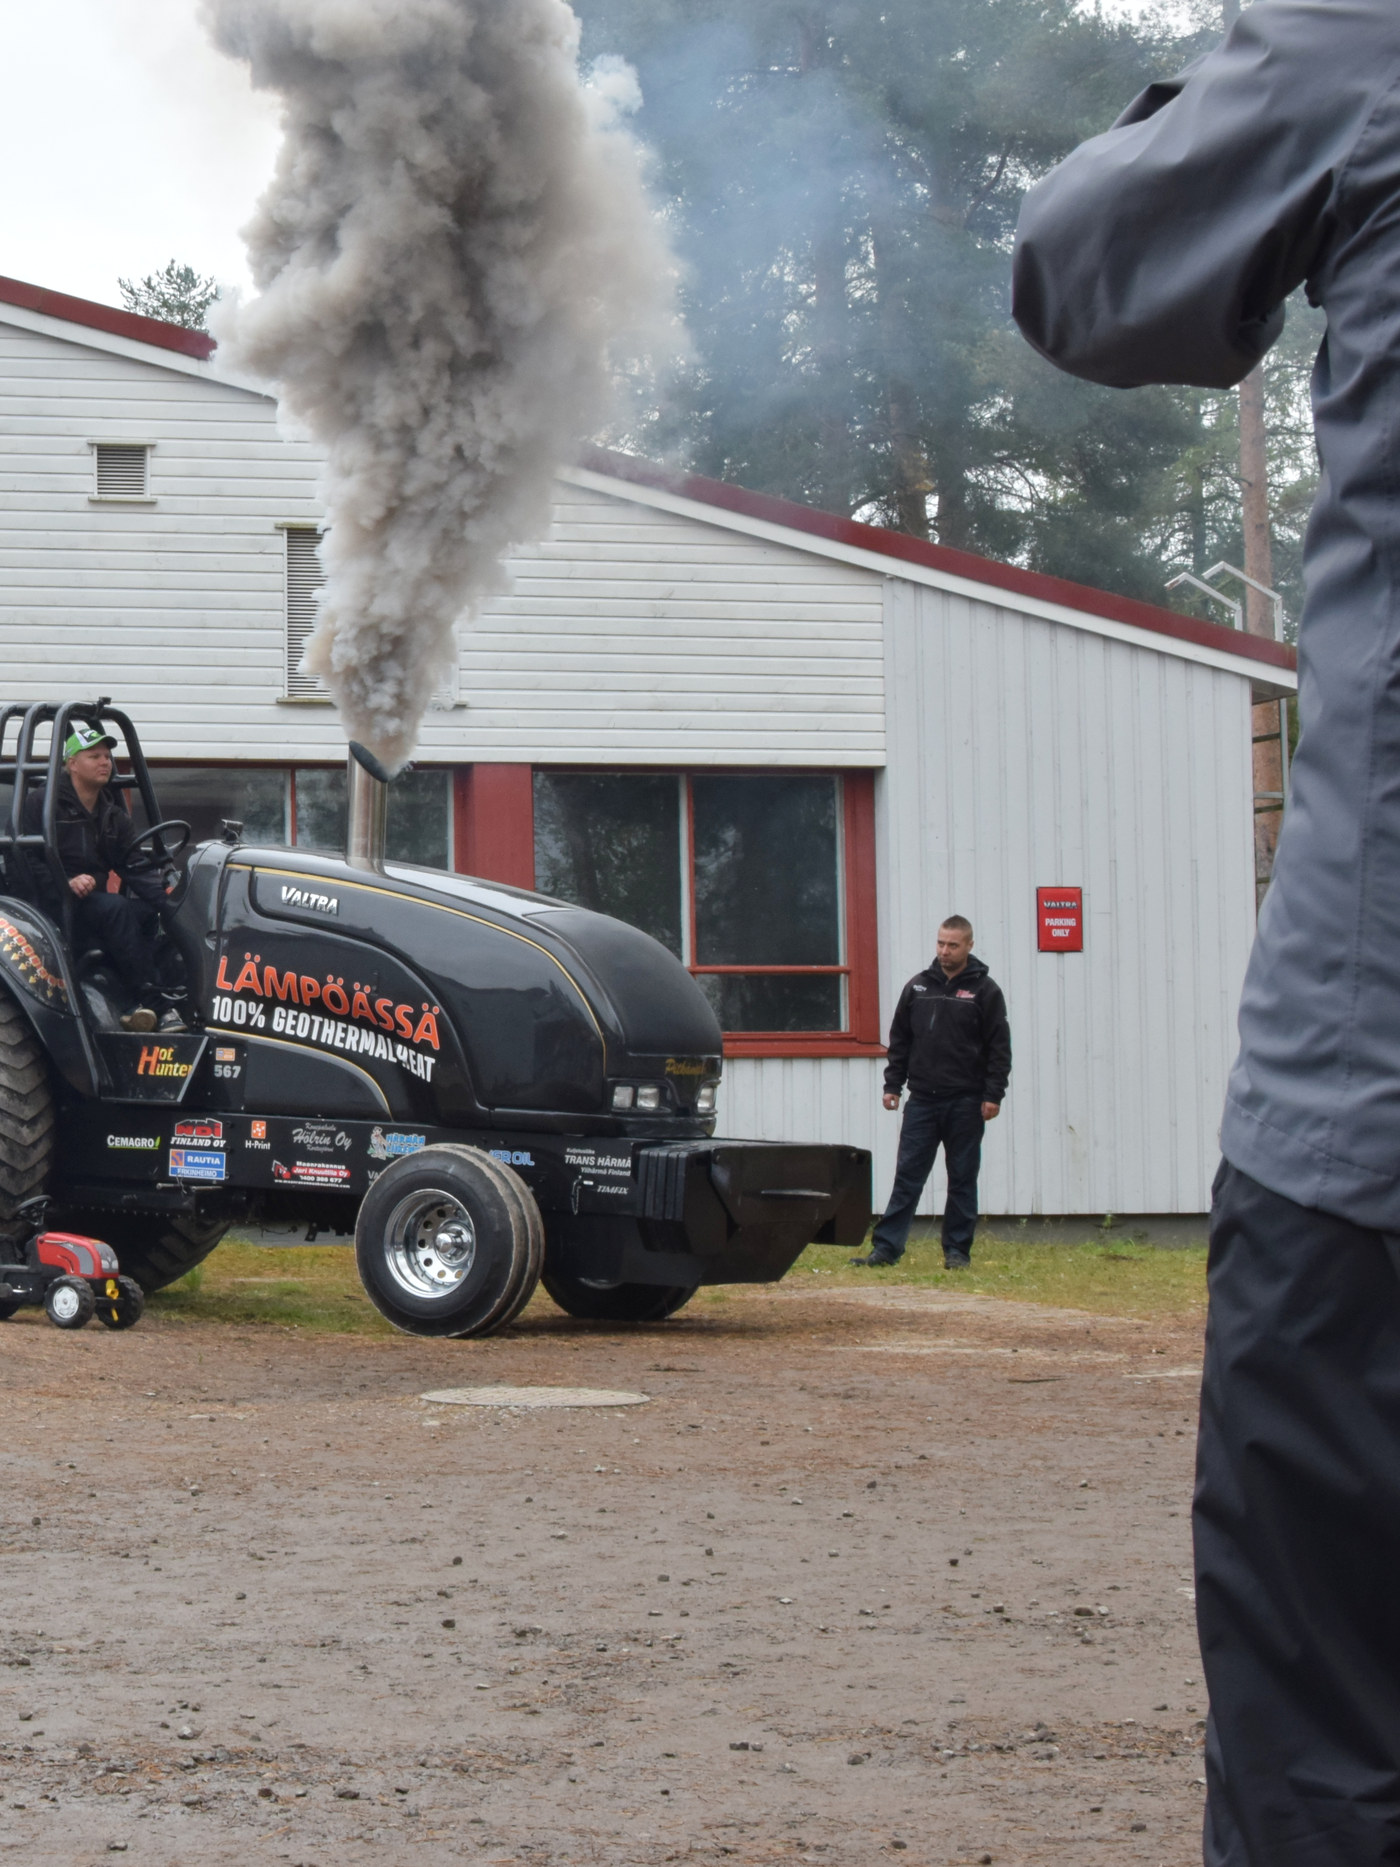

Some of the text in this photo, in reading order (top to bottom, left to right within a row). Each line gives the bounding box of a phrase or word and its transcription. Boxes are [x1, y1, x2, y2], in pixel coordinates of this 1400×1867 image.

[281, 886, 340, 916] VALTRA
[1043, 900, 1078, 909] VALTRA
[1045, 917, 1077, 927] PARKING
[1051, 928, 1070, 937] ONLY
[215, 952, 441, 1051] LÄMPÖÄSSÄ
[212, 995, 266, 1029] 100%
[272, 1006, 398, 1064] GEOTHERMAL
[137, 1046, 175, 1075] Hot
[214, 1064, 241, 1078] 567
[107, 1134, 155, 1148] CEMAGRO
[170, 1136, 226, 1148] FINLAND OY
[245, 1140, 271, 1150] H-Print
[335, 1131, 352, 1151] Oy
[186, 1155, 221, 1165] RAUTIA
[512, 1150, 536, 1167] OIL
[564, 1154, 632, 1168] TRANS HÄRMÄ
[177, 1166, 217, 1177] ERKINHEIMO
[607, 1169, 632, 1177] Finland
